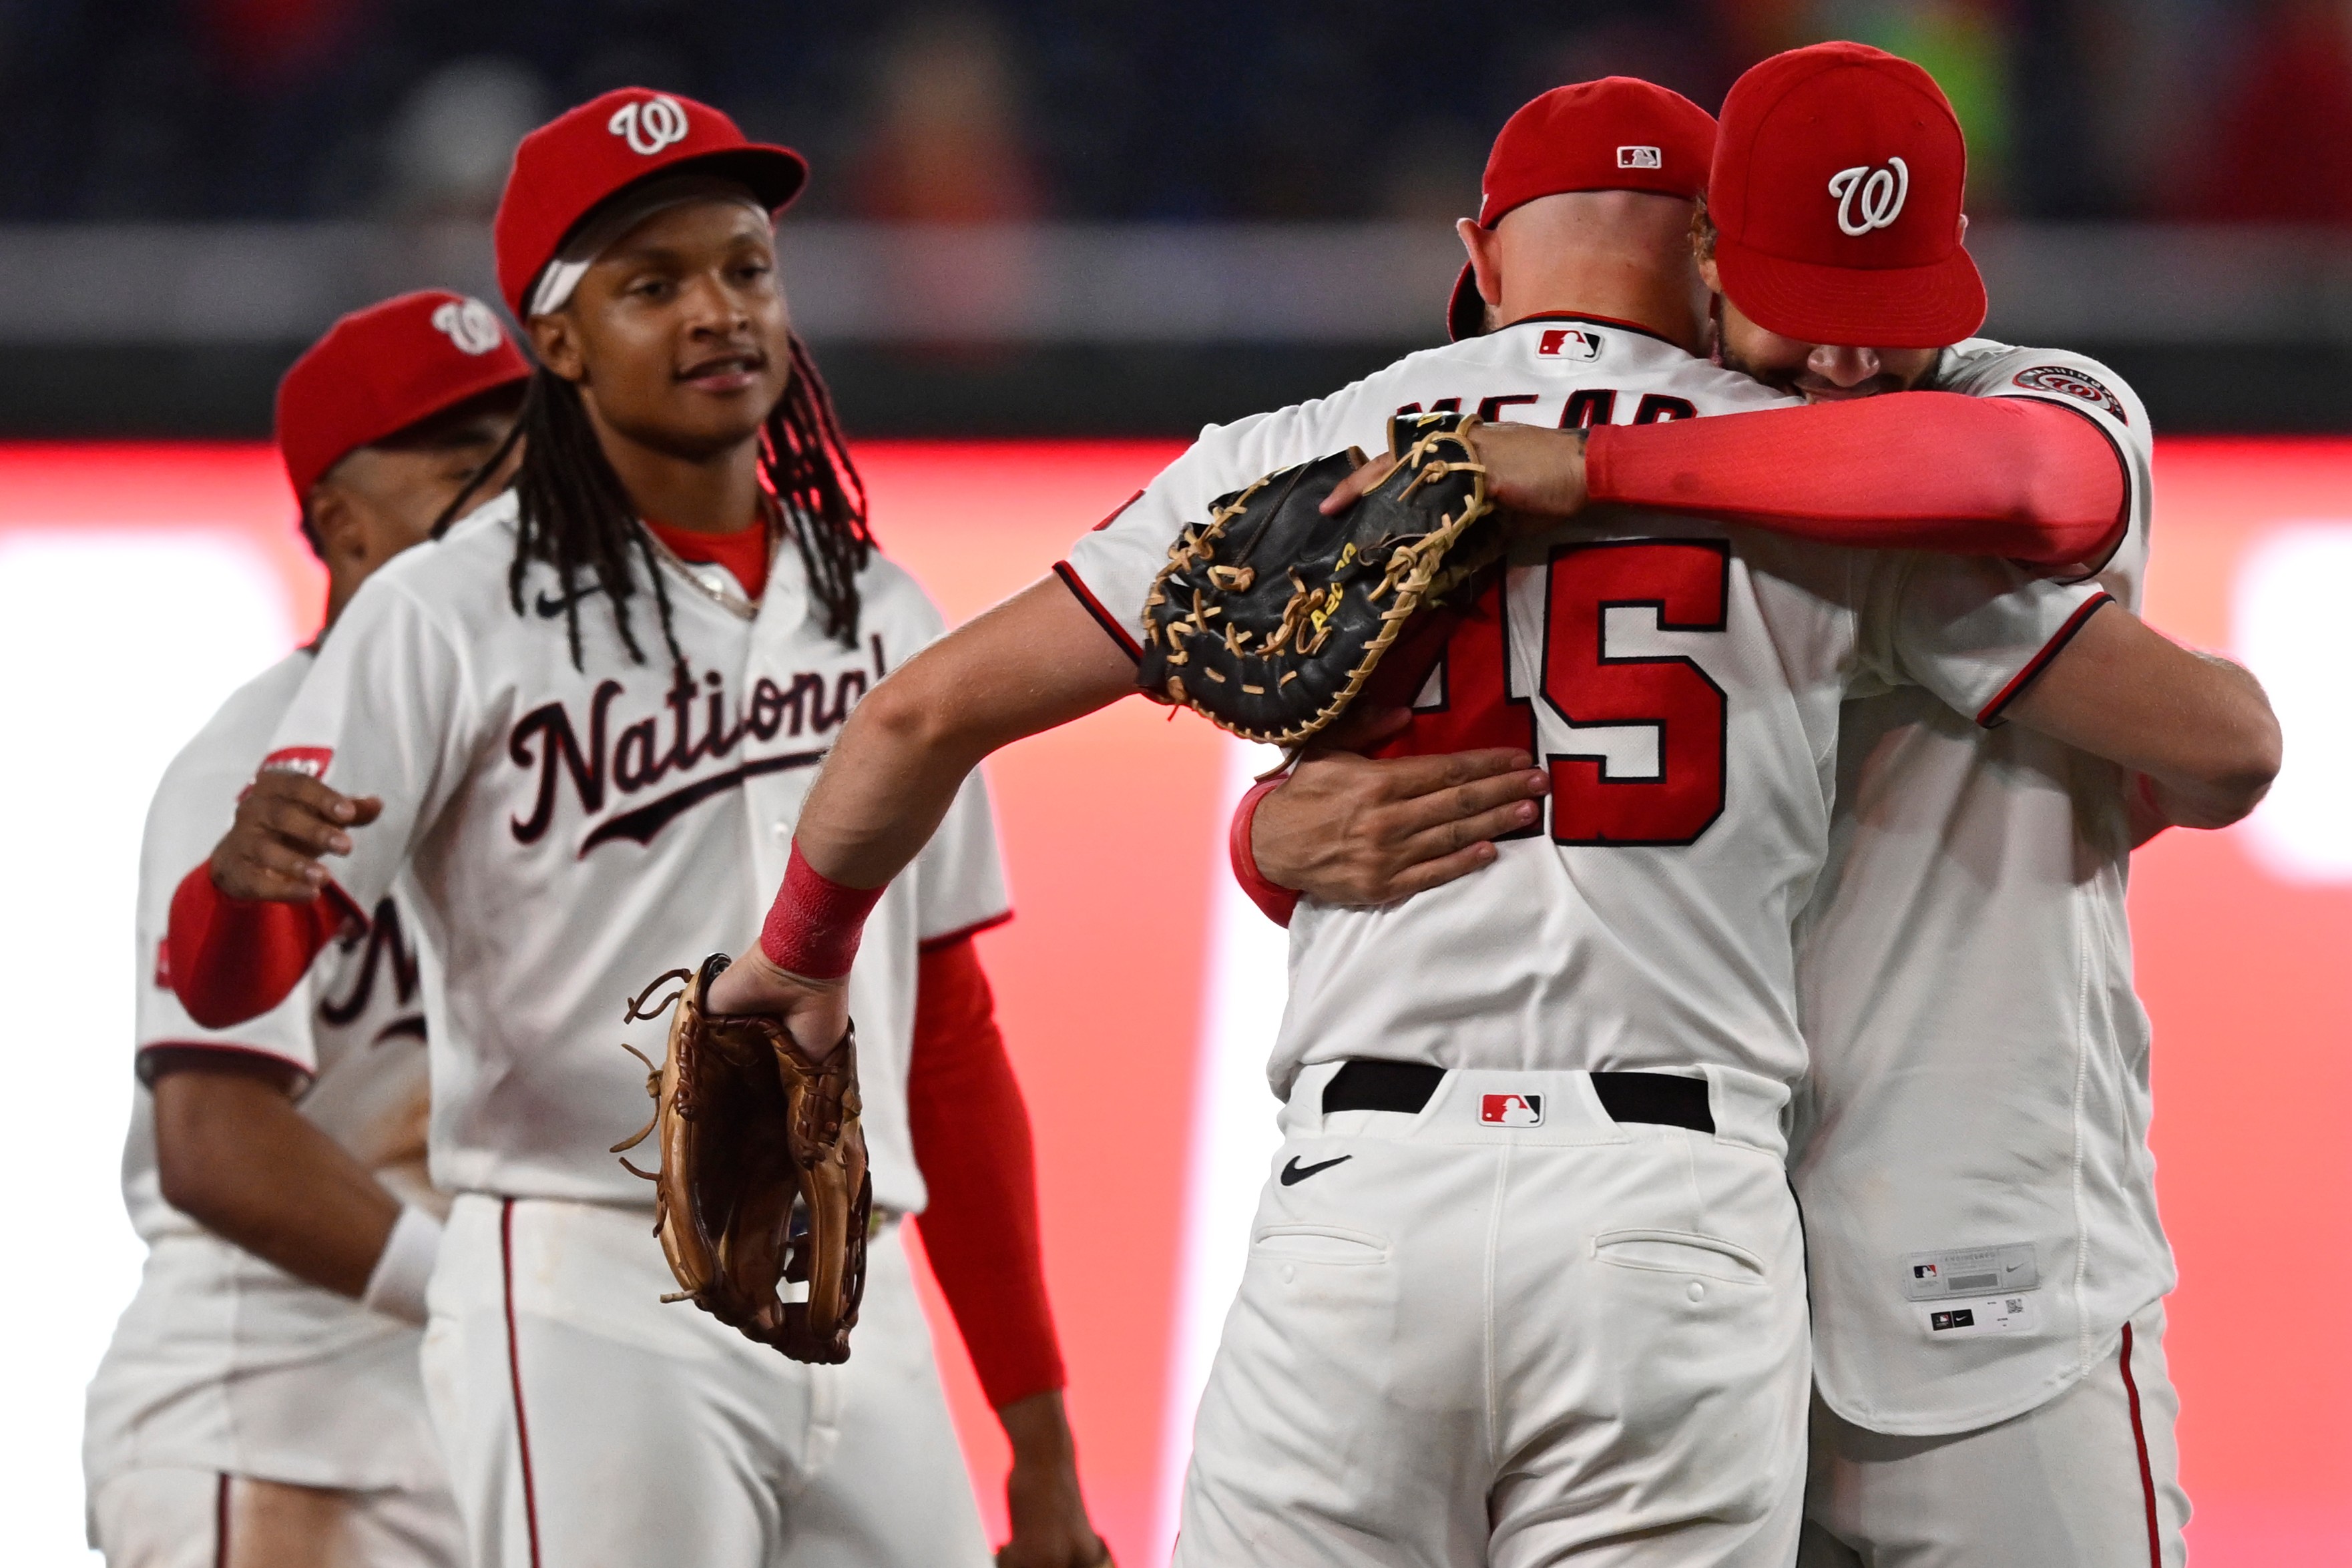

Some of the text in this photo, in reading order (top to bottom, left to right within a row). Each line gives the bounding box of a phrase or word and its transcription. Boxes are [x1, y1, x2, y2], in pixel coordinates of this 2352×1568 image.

[608, 94, 688, 155] W
[1829, 156, 1909, 236] W
[509, 632, 887, 845] National
